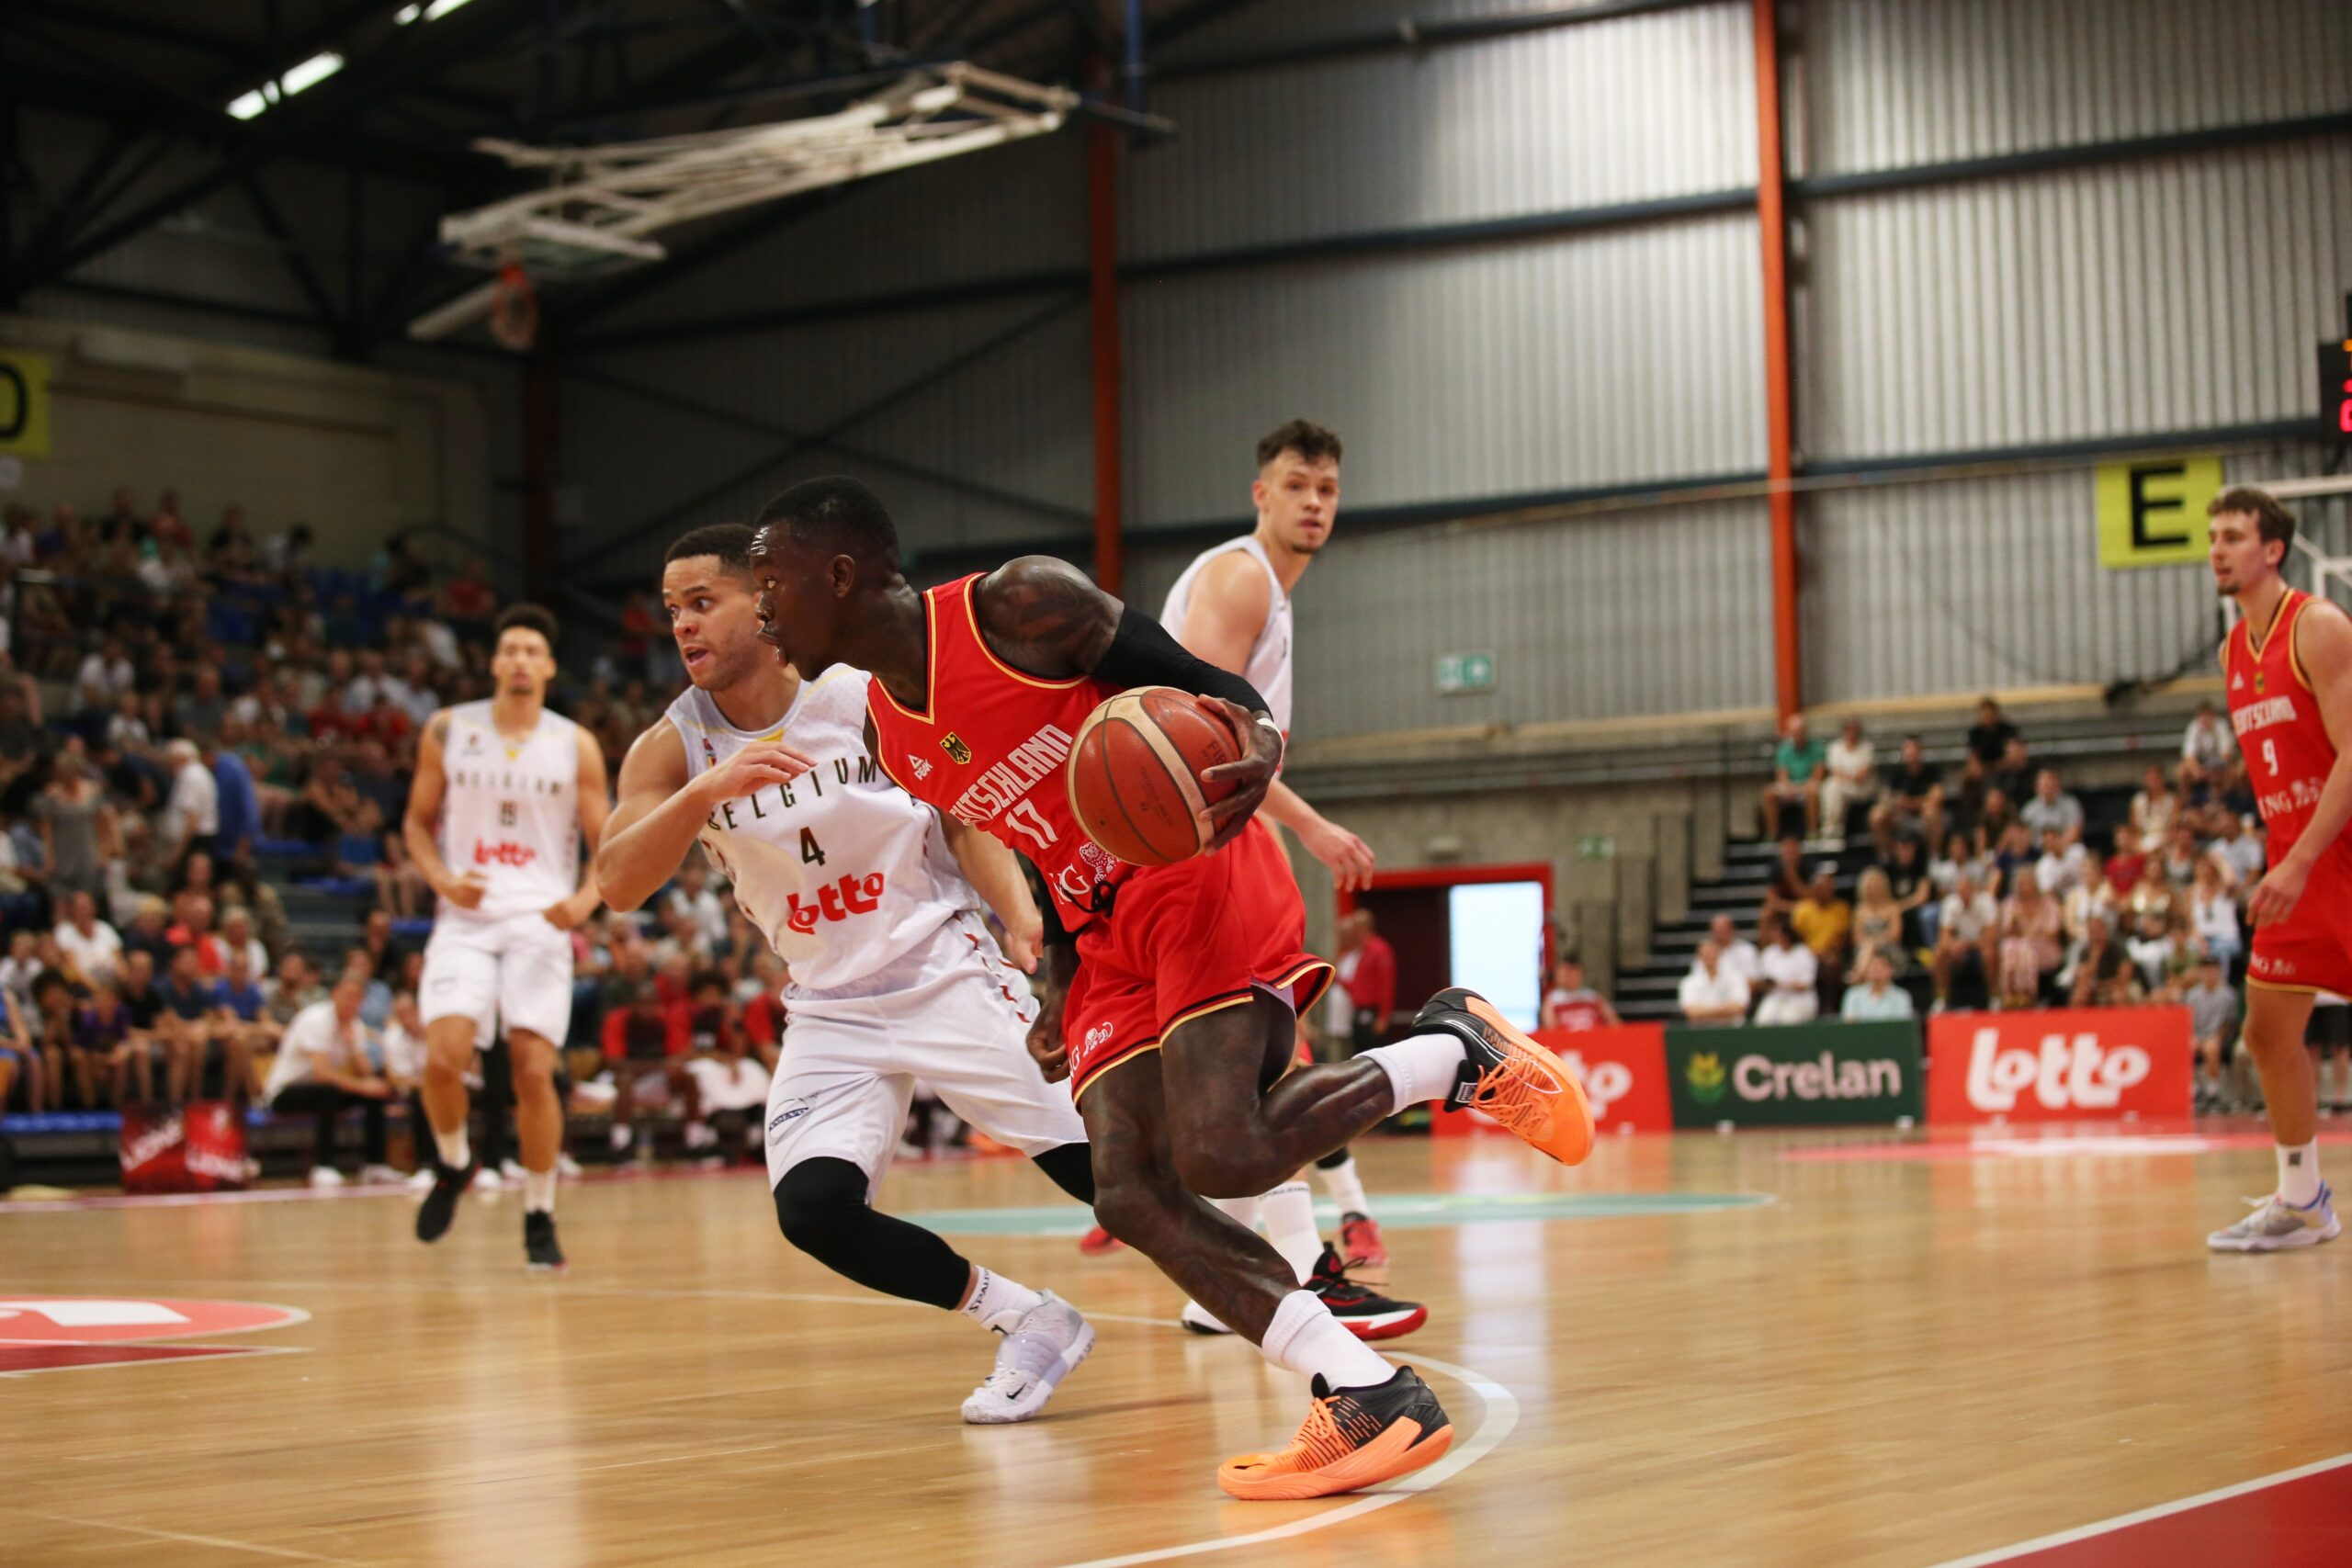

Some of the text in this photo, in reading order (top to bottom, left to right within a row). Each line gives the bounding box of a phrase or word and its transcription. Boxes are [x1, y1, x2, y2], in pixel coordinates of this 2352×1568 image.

[2130, 463, 2190, 548] E
[949, 724, 1073, 826] EUTSCHLAND
[2262, 738, 2278, 776] 9
[800, 827, 826, 866] 4
[1005, 797, 1058, 850] 17
[1733, 1050, 1902, 1100] Crelan
